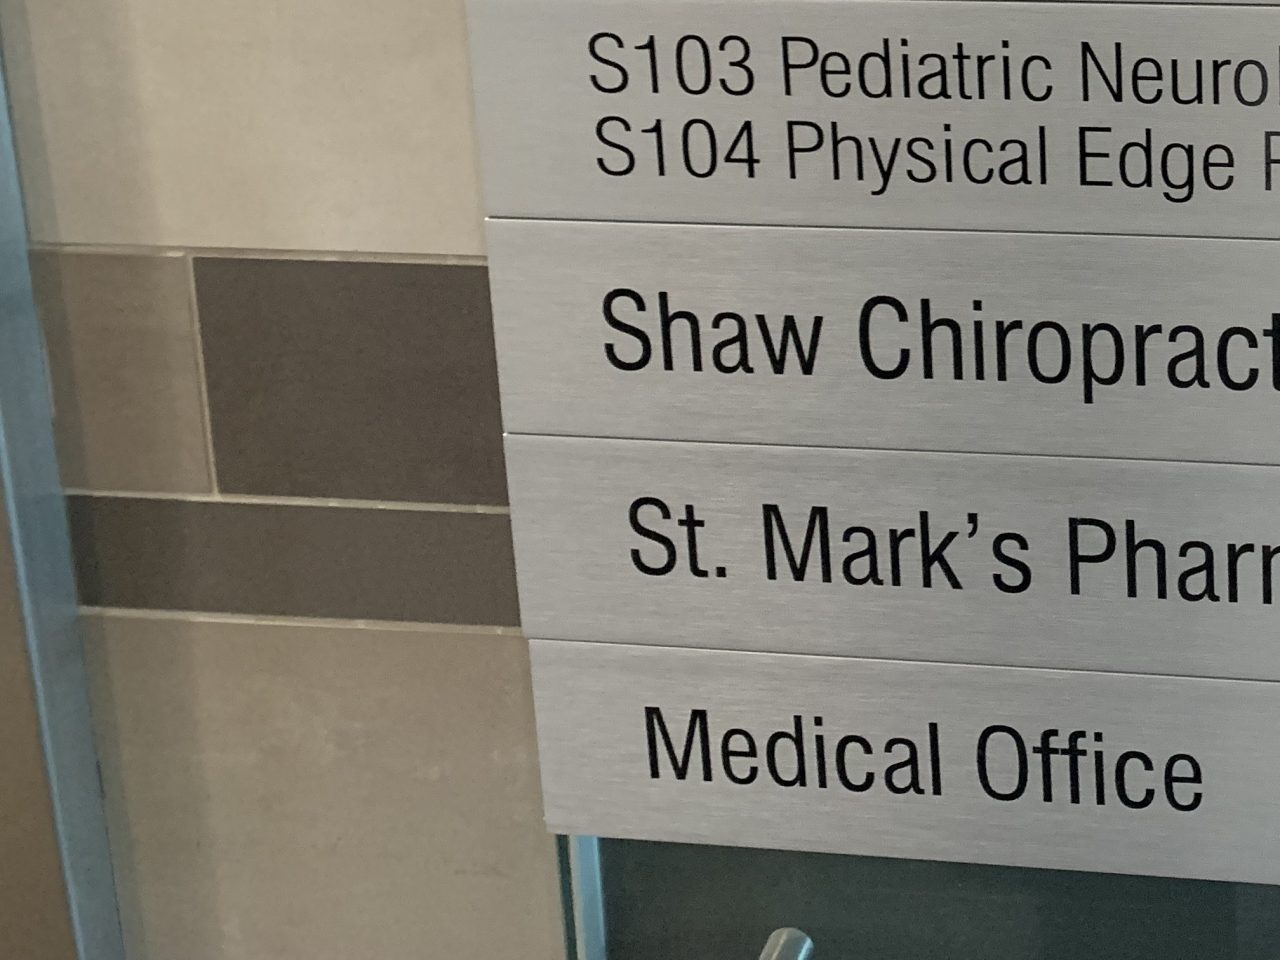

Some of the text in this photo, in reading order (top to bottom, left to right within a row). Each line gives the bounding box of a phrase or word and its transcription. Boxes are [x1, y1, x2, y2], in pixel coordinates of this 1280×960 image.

[588, 32, 755, 97] S103
[781, 36, 1053, 103] Pediatric
[595, 115, 761, 179] S104
[786, 120, 1048, 196] Physical
[1078, 126, 1235, 204] Edge
[602, 288, 824, 376] Shaw
[628, 496, 729, 584] St.
[761, 503, 1032, 594] Mark's
[644, 706, 1203, 812] Medical Office
